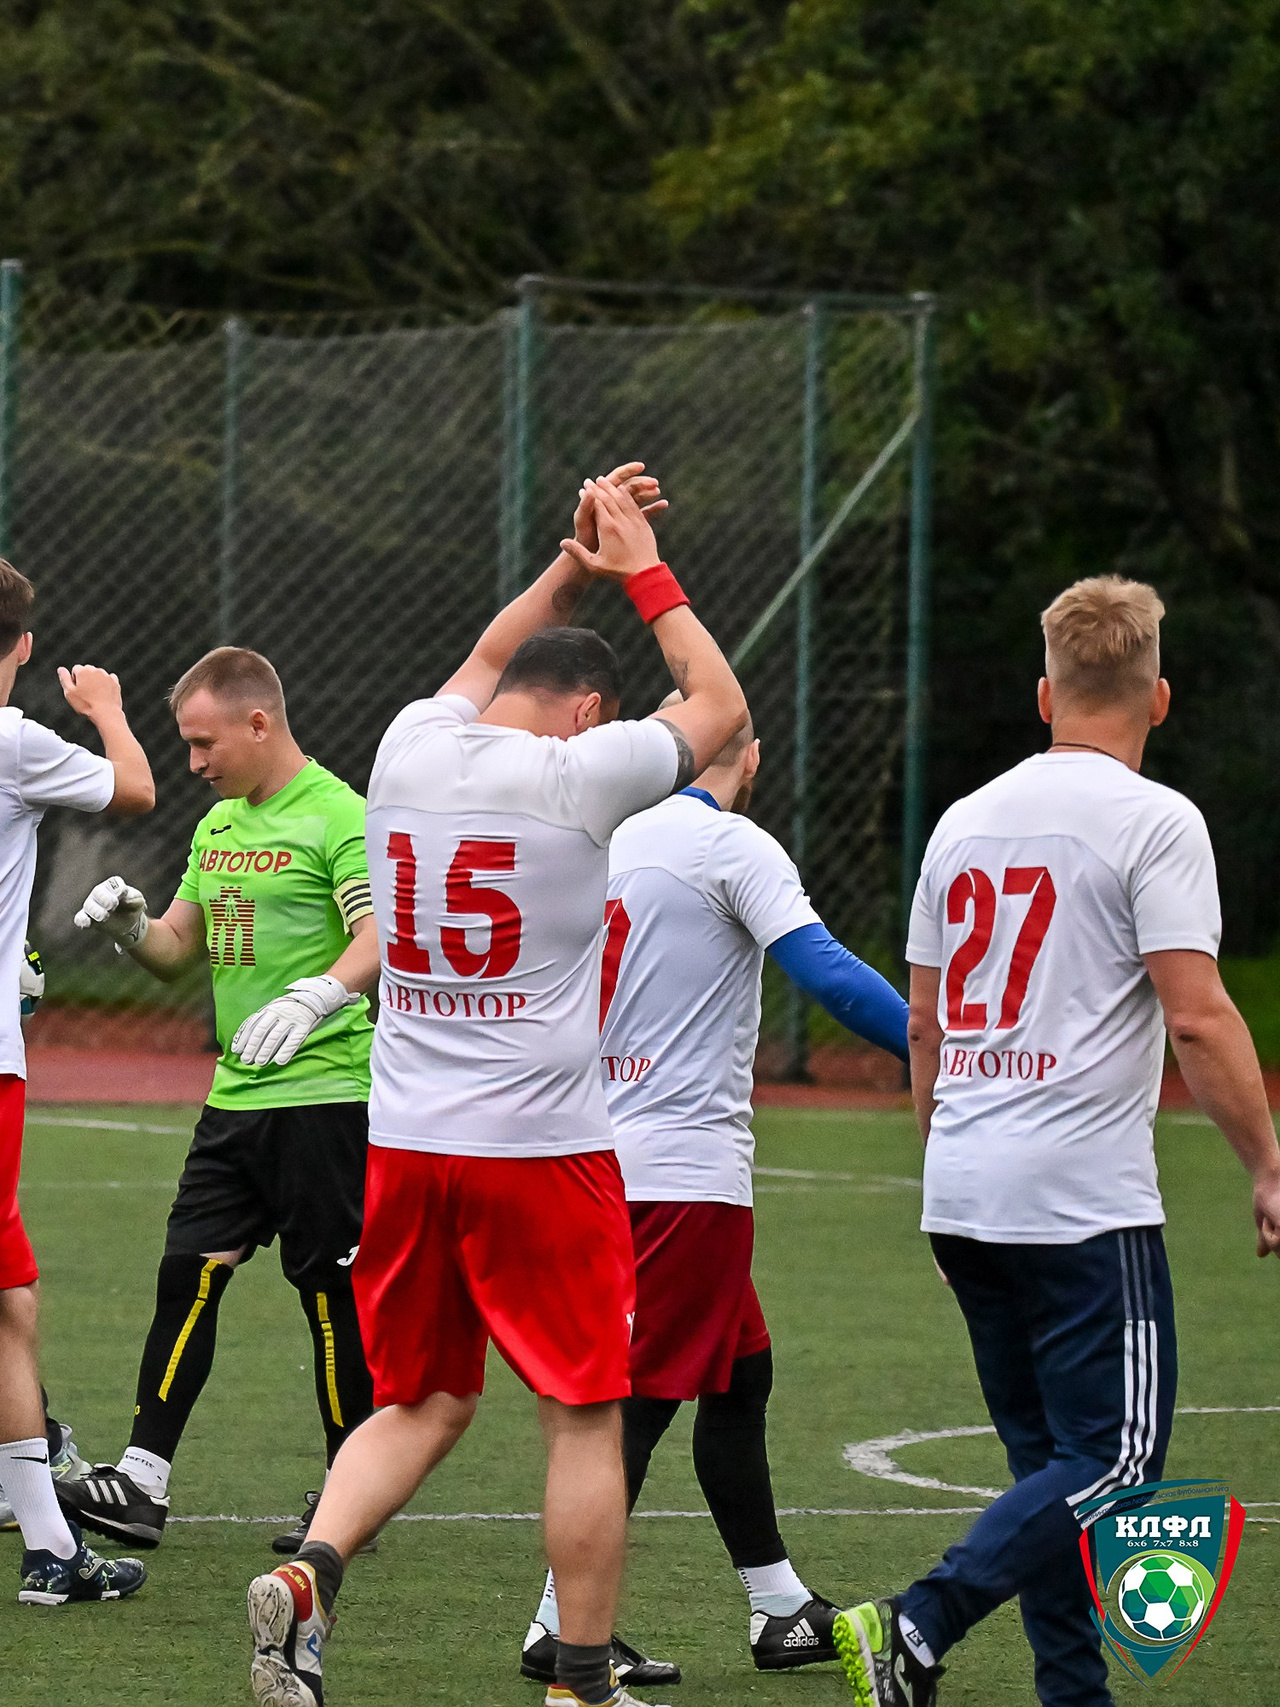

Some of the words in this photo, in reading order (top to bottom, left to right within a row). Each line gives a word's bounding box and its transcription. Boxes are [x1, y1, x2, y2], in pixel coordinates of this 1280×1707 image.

[200, 849, 292, 873] АВТОТОР
[386, 832, 523, 979] 15
[944, 866, 1057, 1031] 27
[385, 983, 527, 1018] АВТОТОР
[941, 1048, 1057, 1081] АВТОТОР
[783, 1636, 819, 1648] adidas
